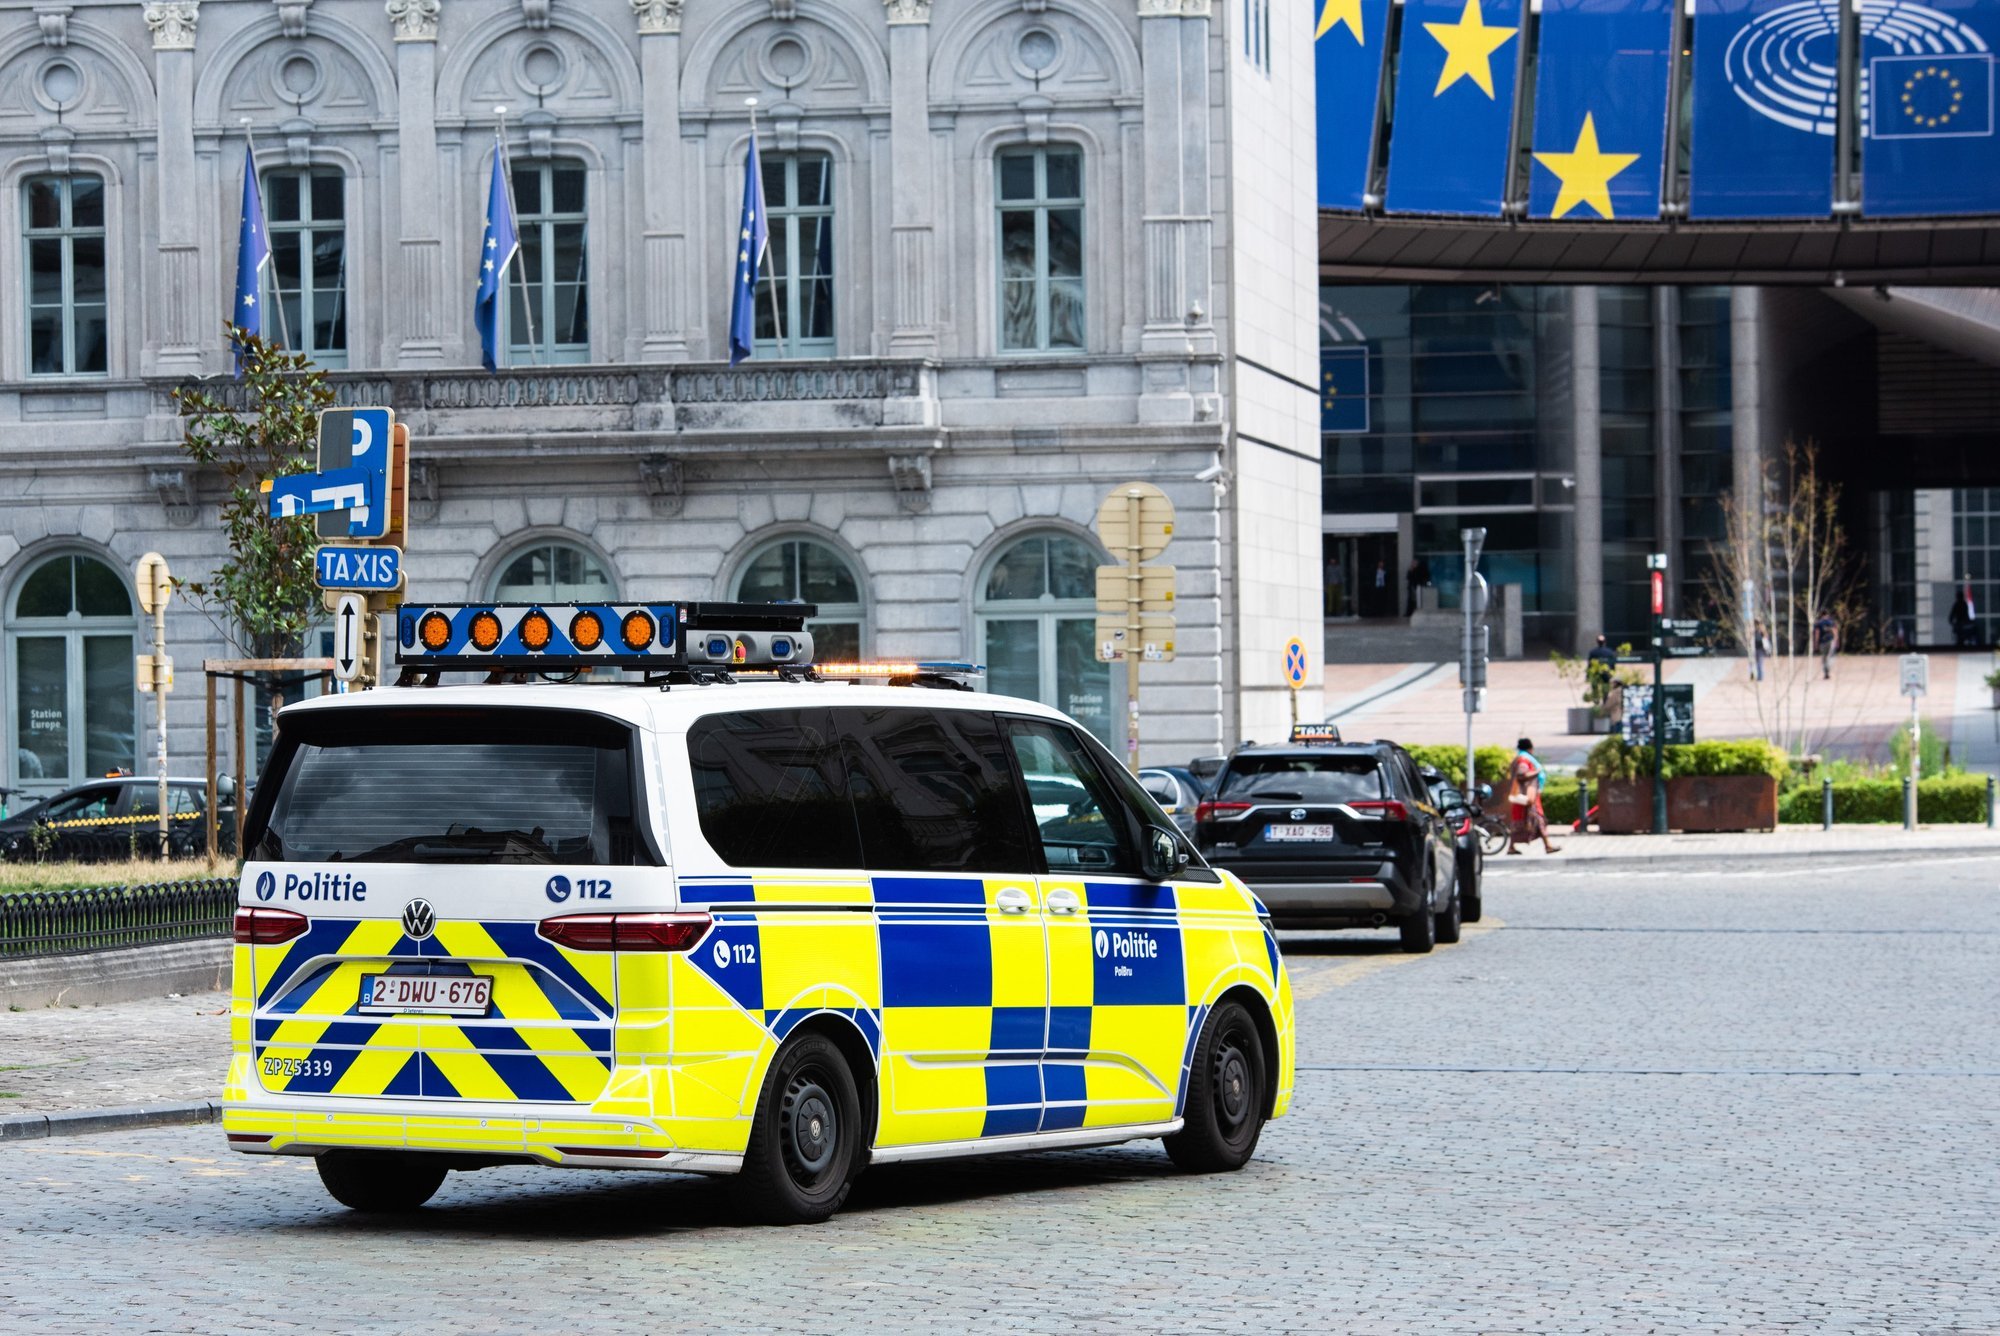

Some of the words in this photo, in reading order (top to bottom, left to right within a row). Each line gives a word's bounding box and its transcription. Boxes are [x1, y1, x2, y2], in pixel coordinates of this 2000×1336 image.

[322, 553, 393, 583] TAXIS
[31, 709, 62, 719] Station
[31, 720, 61, 731] Europe
[1300, 726, 1331, 735] TAXI
[284, 872, 367, 901] Politie
[576, 879, 612, 899] 112
[732, 944, 756, 964] 112
[1112, 931, 1158, 958] Politie
[1114, 965, 1133, 977] PolBru
[363, 993, 371, 1004] B
[264, 1058, 332, 1077] ZPZ5339
